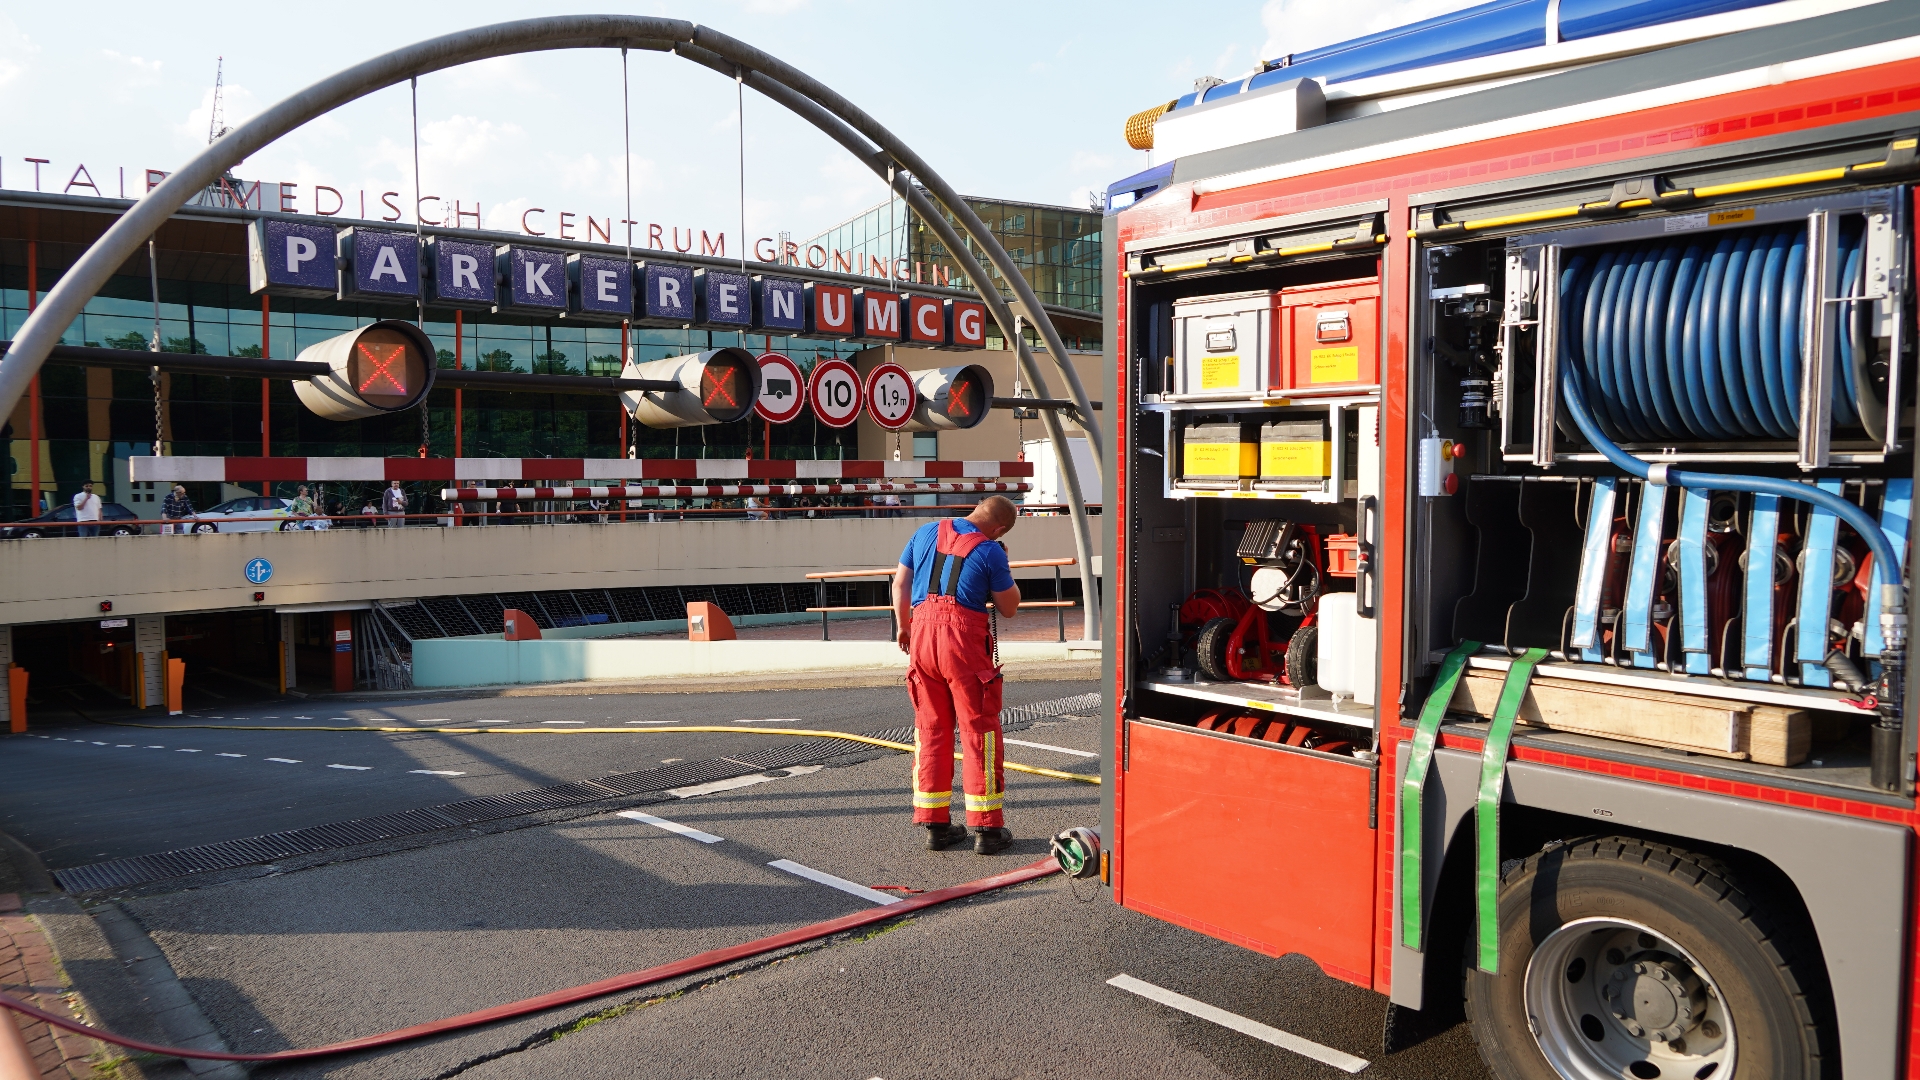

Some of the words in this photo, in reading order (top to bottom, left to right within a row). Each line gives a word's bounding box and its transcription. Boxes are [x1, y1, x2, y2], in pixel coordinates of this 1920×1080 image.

[221, 176, 480, 230] MEDISCH
[521, 207, 725, 258] CENTRUM
[754, 237, 949, 288] GRONINGEN
[1726, 212, 1744, 220] meter
[286, 235, 795, 320] PARKEREN
[822, 292, 981, 340] UMCG
[824, 379, 852, 407] 10
